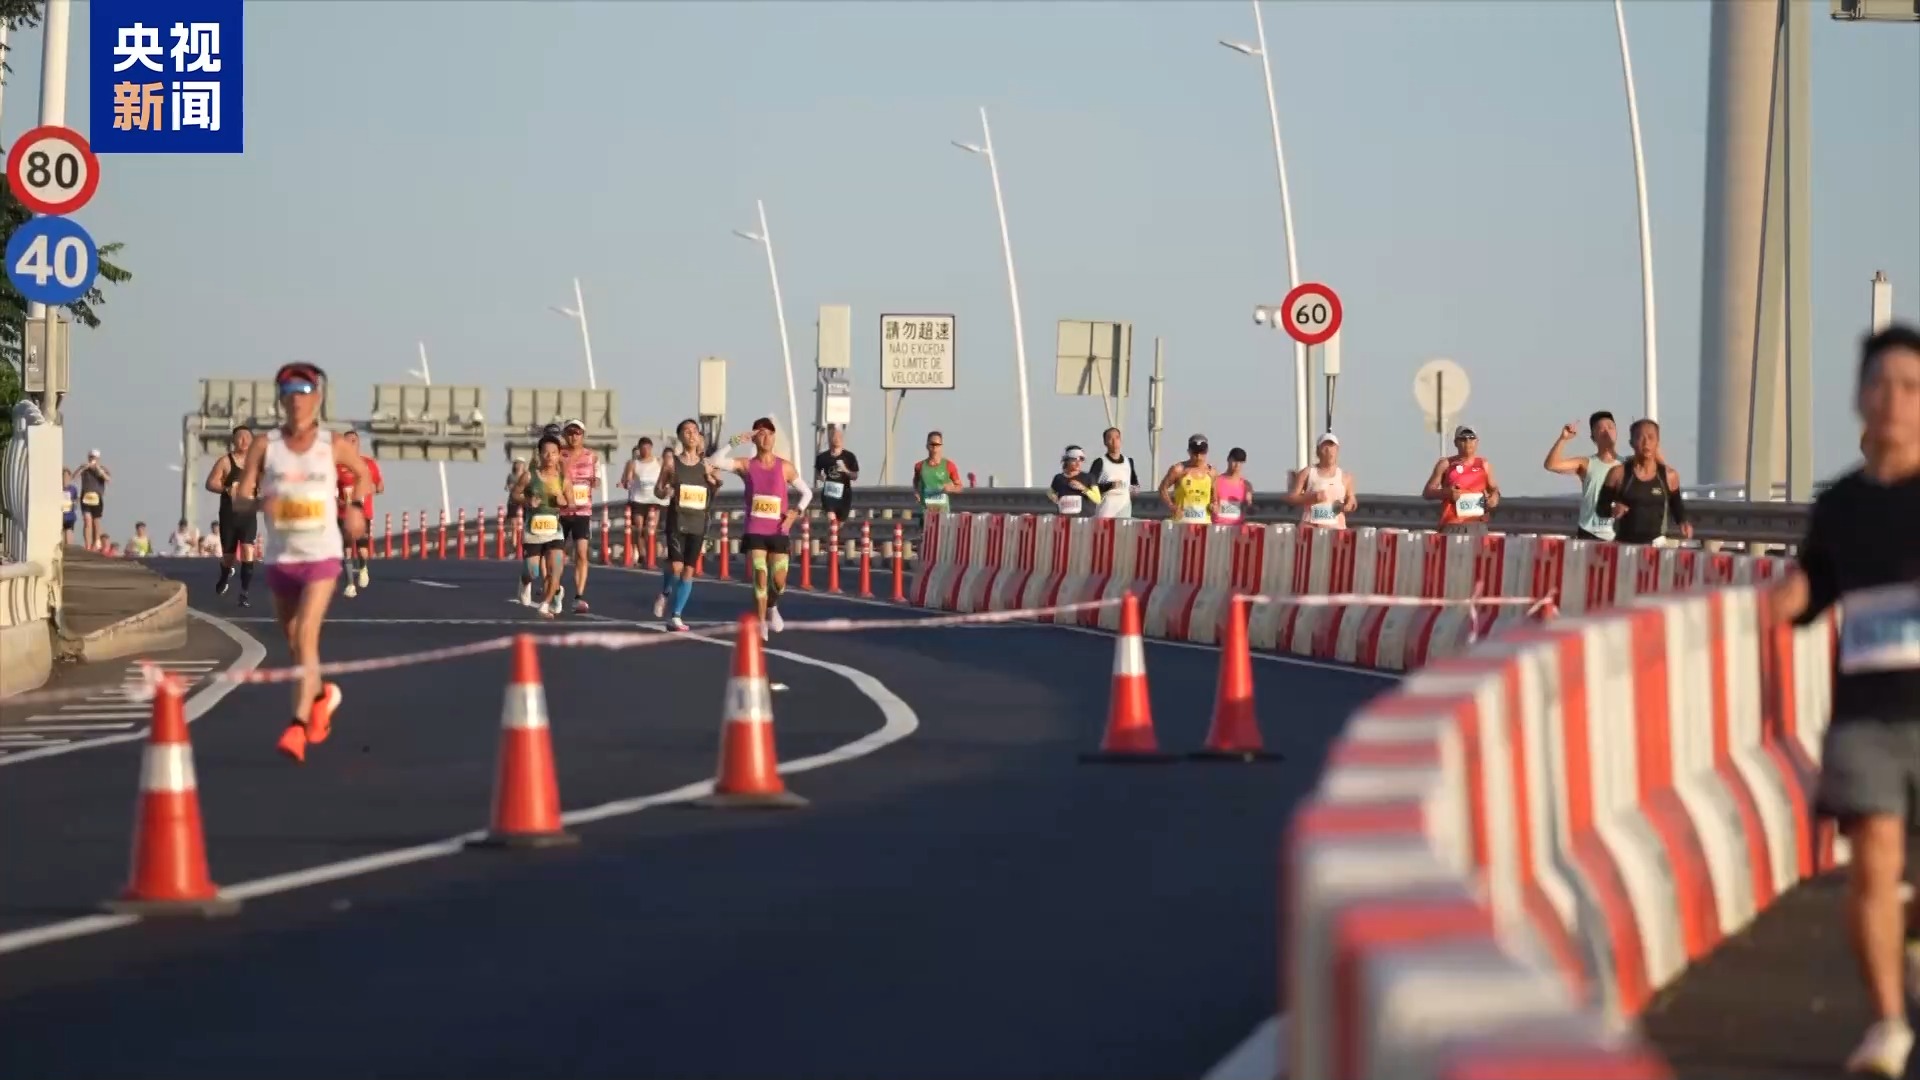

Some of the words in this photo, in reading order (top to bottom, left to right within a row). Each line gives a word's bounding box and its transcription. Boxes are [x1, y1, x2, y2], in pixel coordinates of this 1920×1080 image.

[27, 151, 79, 190] 80
[15, 235, 88, 288] 40
[1296, 303, 1327, 325] 60
[886, 321, 950, 340] 請勿超速
[911, 343, 945, 355] EXCEDA
[893, 357, 900, 369] O
[902, 357, 929, 369] LIMITE
[930, 357, 942, 369] DE
[891, 371, 945, 384] VELOCIDADE
